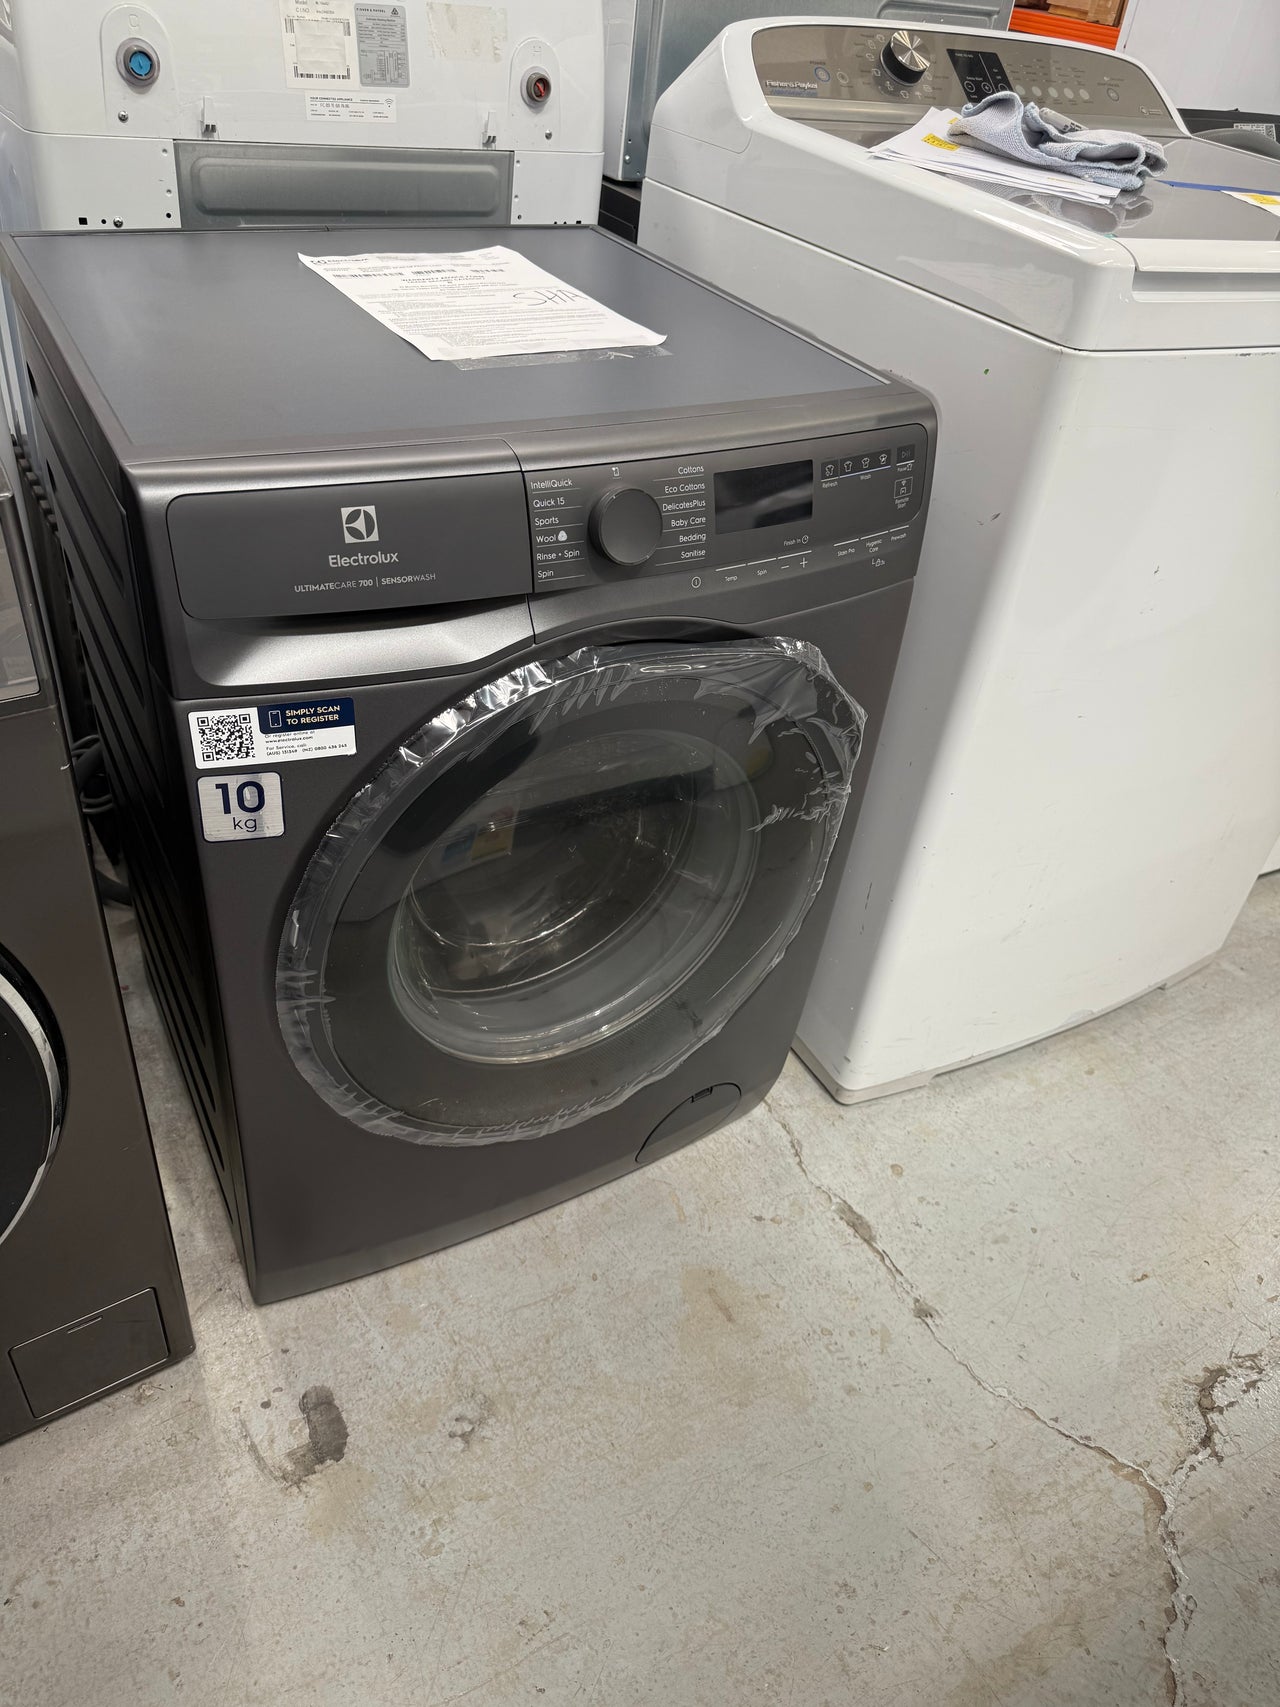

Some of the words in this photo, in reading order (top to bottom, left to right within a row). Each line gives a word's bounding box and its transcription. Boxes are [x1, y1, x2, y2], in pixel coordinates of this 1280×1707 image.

[678, 465, 704, 474] Cottons
[531, 478, 572, 490] IntelliQuick
[664, 484, 678, 494] Eco
[679, 482, 705, 492] Cottons
[533, 498, 556, 508] Quick
[662, 500, 706, 511] DelicatesPlus
[535, 517, 559, 526] Sports
[671, 518, 688, 529] Baby
[690, 516, 706, 524] Care
[536, 534, 556, 543] Wool
[679, 533, 706, 544] Bedding
[328, 551, 399, 568] Electrolux
[537, 552, 557, 561] Rinse
[564, 550, 580, 559] Spin
[681, 549, 706, 559] Sanitise
[538, 570, 554, 579] Spin
[294, 580, 357, 592] ULTIMATECARE
[358, 579, 373, 587] 700
[381, 573, 436, 585] SENSORWASH
[286, 708, 315, 716] SIMPLY
[300, 714, 339, 724] REGISTER
[215, 780, 265, 815] 10
[232, 816, 257, 833] kg
